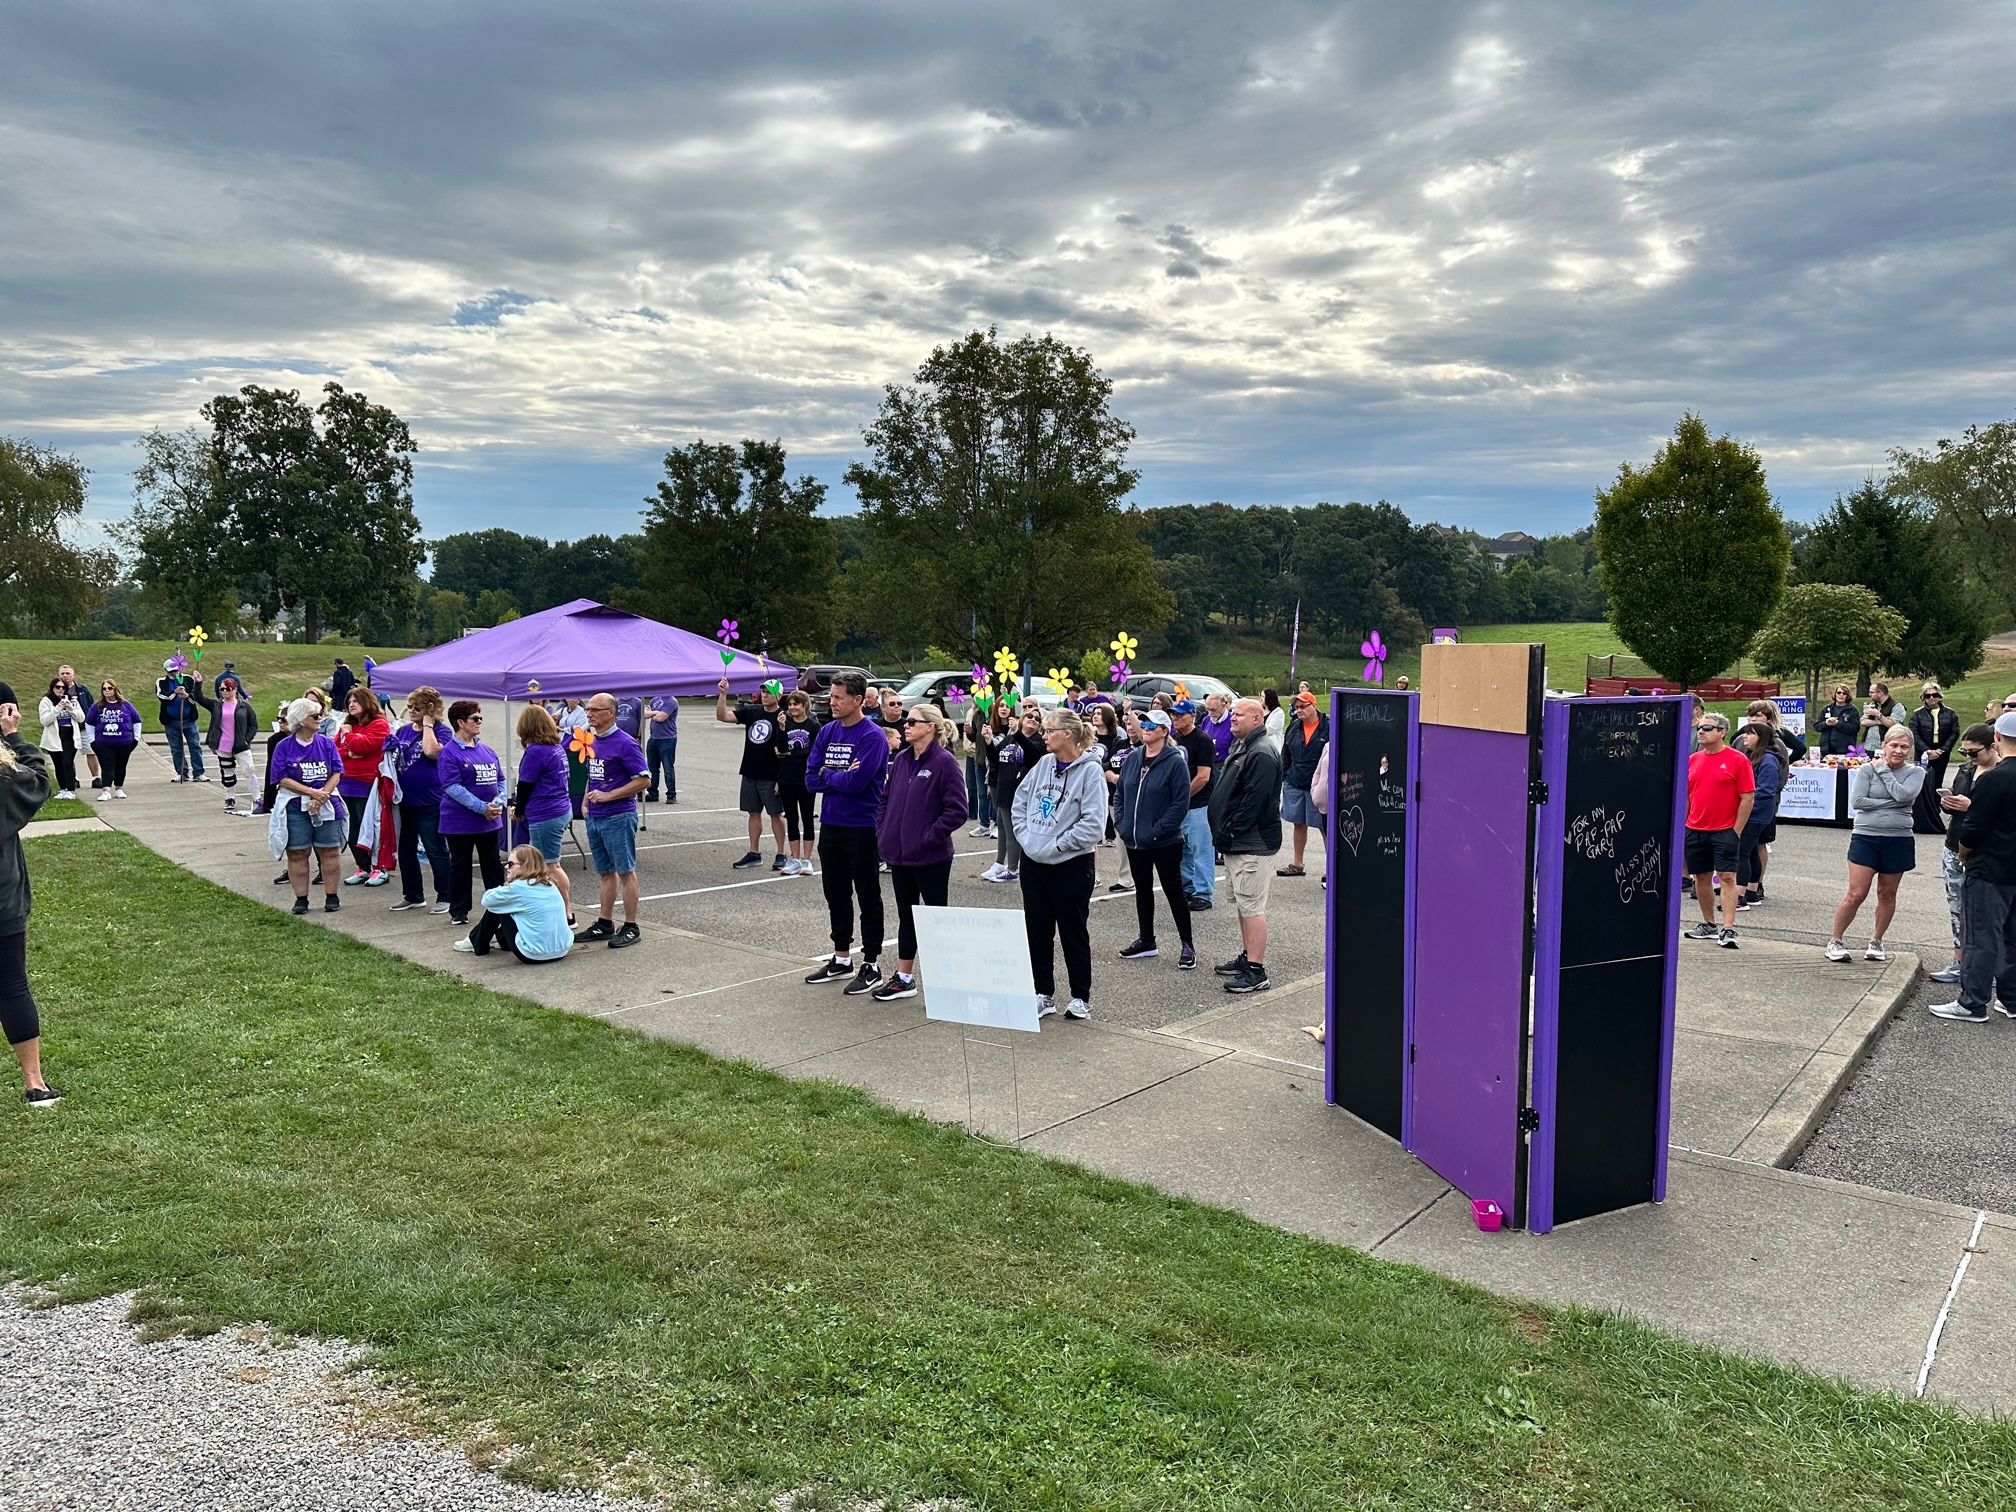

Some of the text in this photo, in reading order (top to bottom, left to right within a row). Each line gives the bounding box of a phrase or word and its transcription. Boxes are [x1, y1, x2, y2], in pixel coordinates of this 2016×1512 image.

[300, 761, 326, 769] WALK
[473, 763, 497, 771] WALK
[308, 767, 328, 776] END
[482, 769, 497, 778] END
[1786, 777, 1819, 786] utheran
[1614, 854, 1641, 884] Miss
[1619, 842, 1662, 903] Grammy
